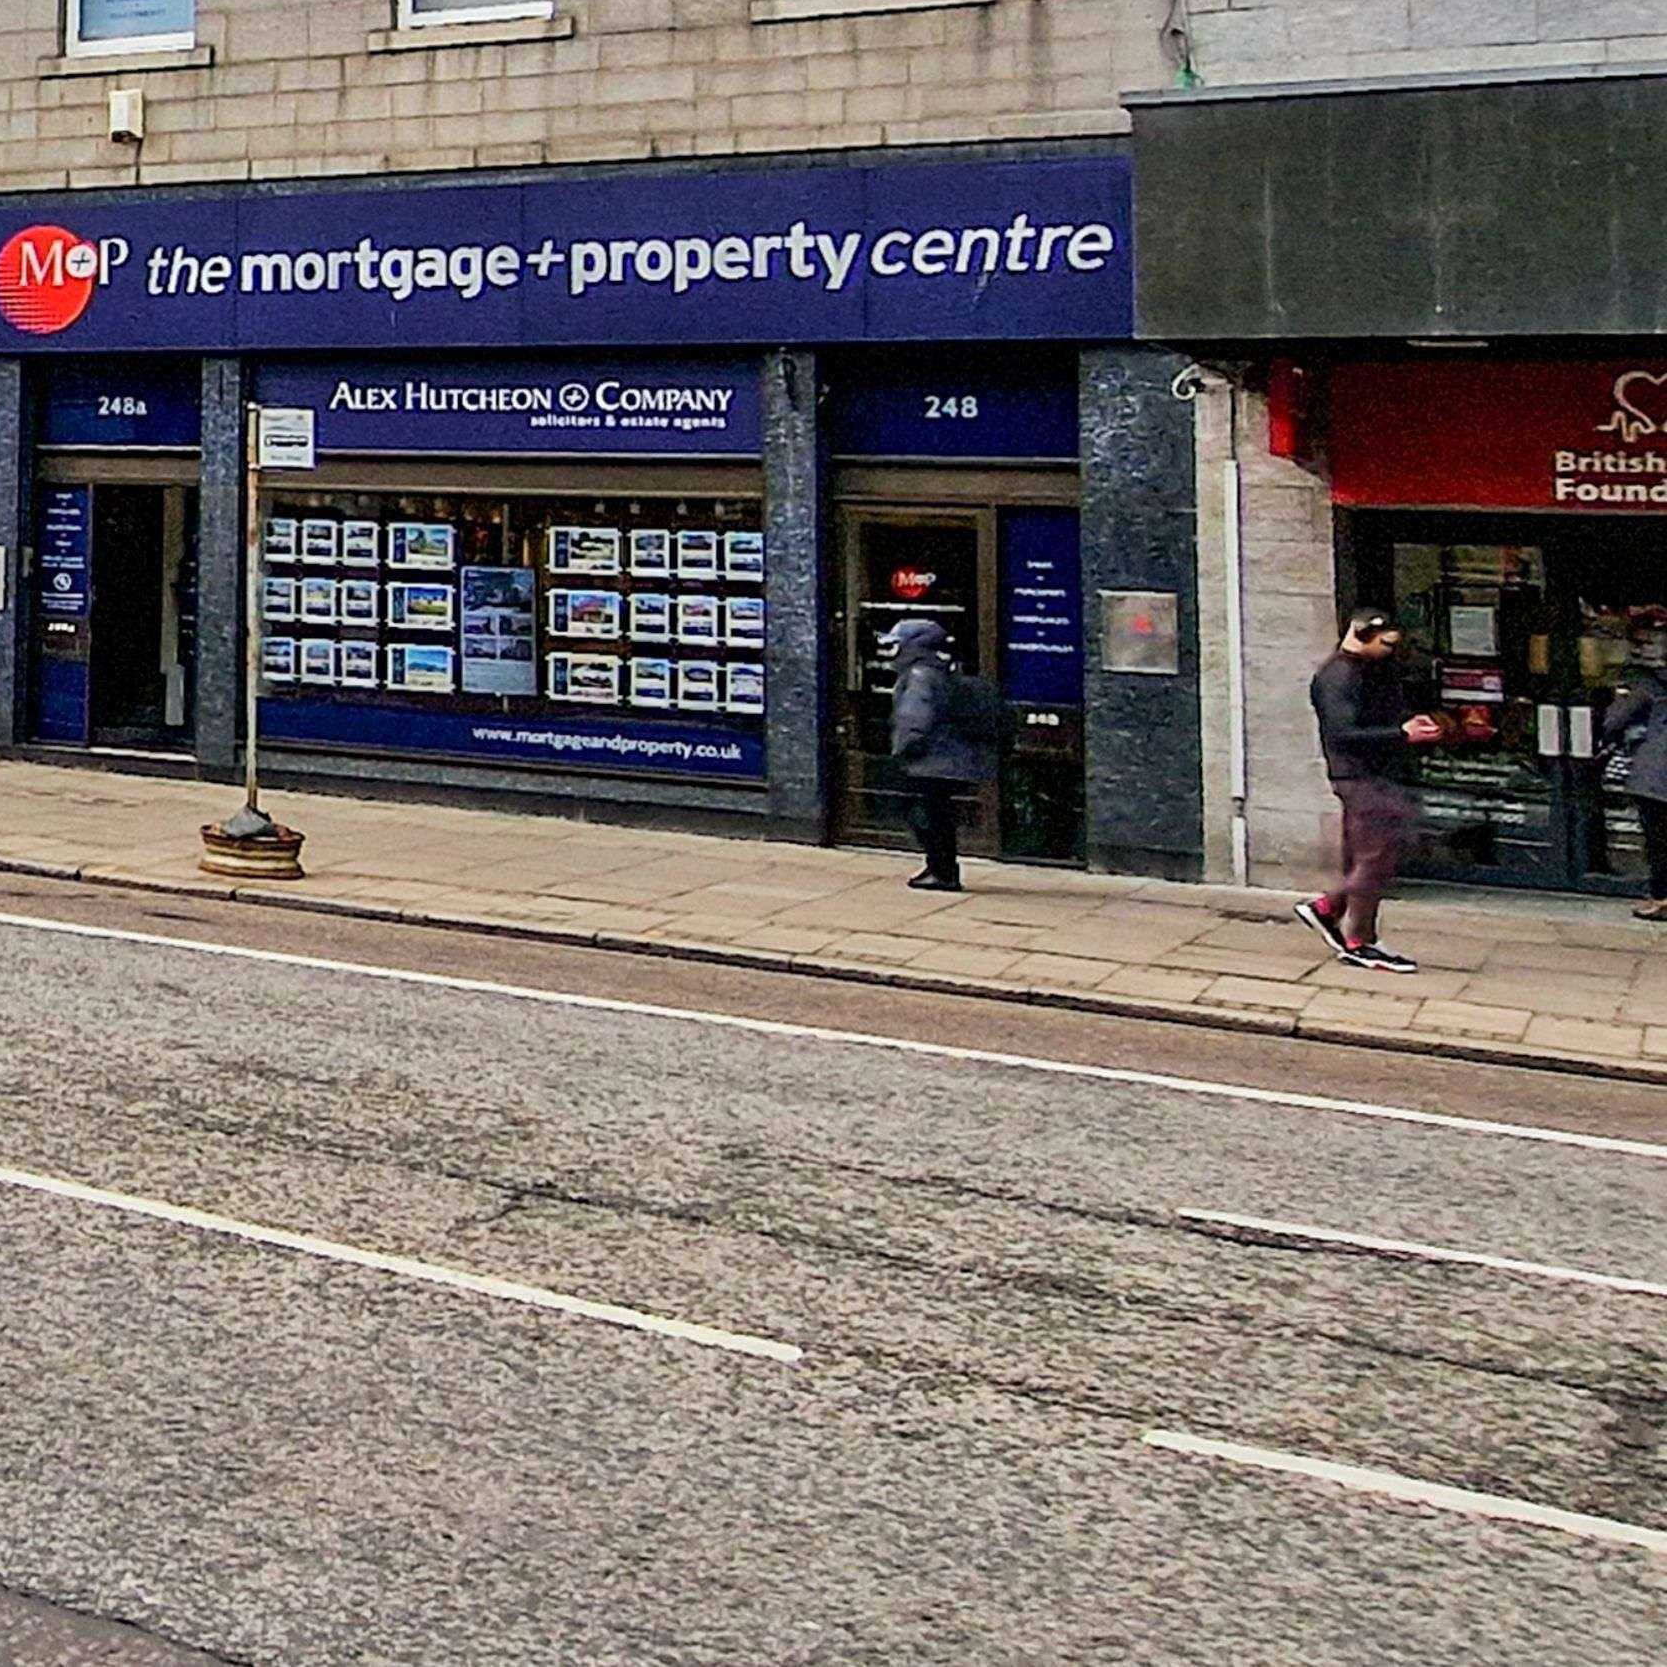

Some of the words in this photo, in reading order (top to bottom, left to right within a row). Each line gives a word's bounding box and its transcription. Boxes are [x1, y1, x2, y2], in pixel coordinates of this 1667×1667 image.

[146, 245, 232, 295] the
[870, 213, 1114, 276] centre
[98, 396, 147, 416] 248a
[329, 381, 397, 410] ALEX
[404, 381, 552, 412] HUTCHEON
[595, 380, 733, 412] COMPANY
[924, 395, 978, 418] 248
[530, 413, 600, 428] solicitors
[620, 415, 669, 428] estate
[673, 416, 727, 431] agents
[1554, 450, 1667, 473] British
[472, 727, 743, 761] www.mortgageandproperty.co.uk
